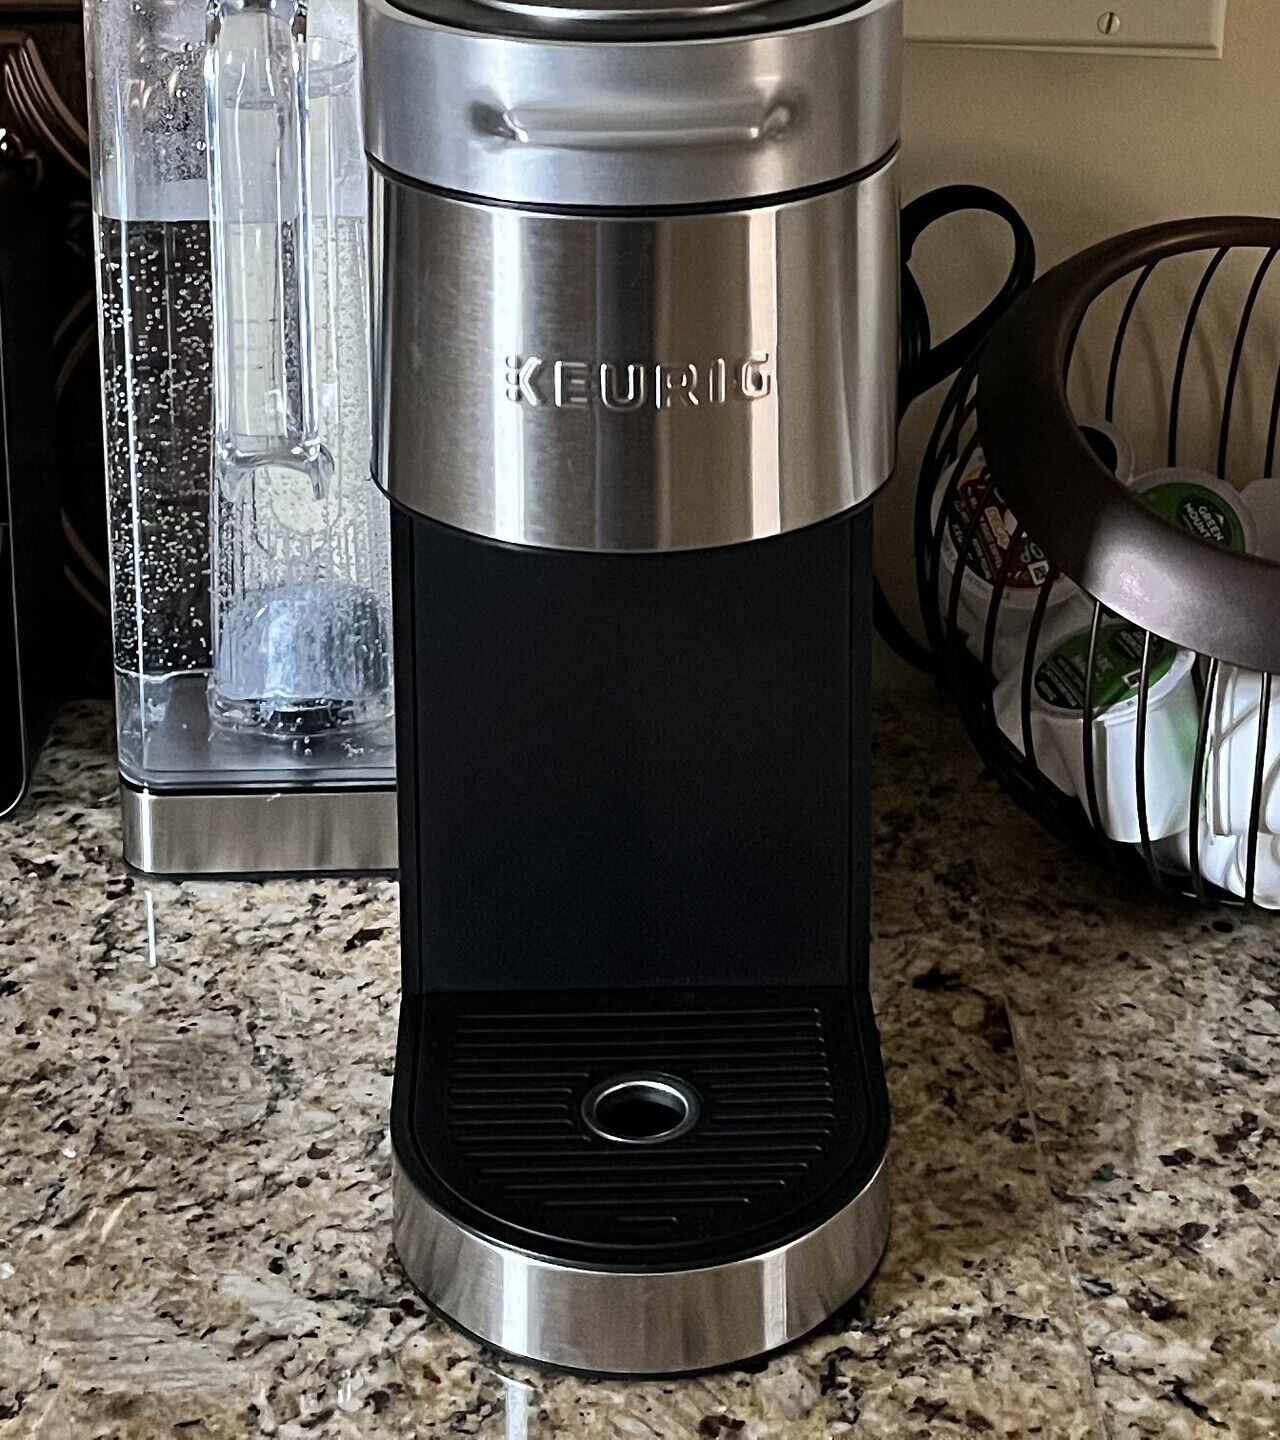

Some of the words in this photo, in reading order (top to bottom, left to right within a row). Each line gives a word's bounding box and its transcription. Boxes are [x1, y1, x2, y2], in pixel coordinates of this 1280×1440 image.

[505, 355, 770, 409] KEURIG
[1184, 502, 1212, 538] MOUNT
[1199, 506, 1225, 541] GREEN
